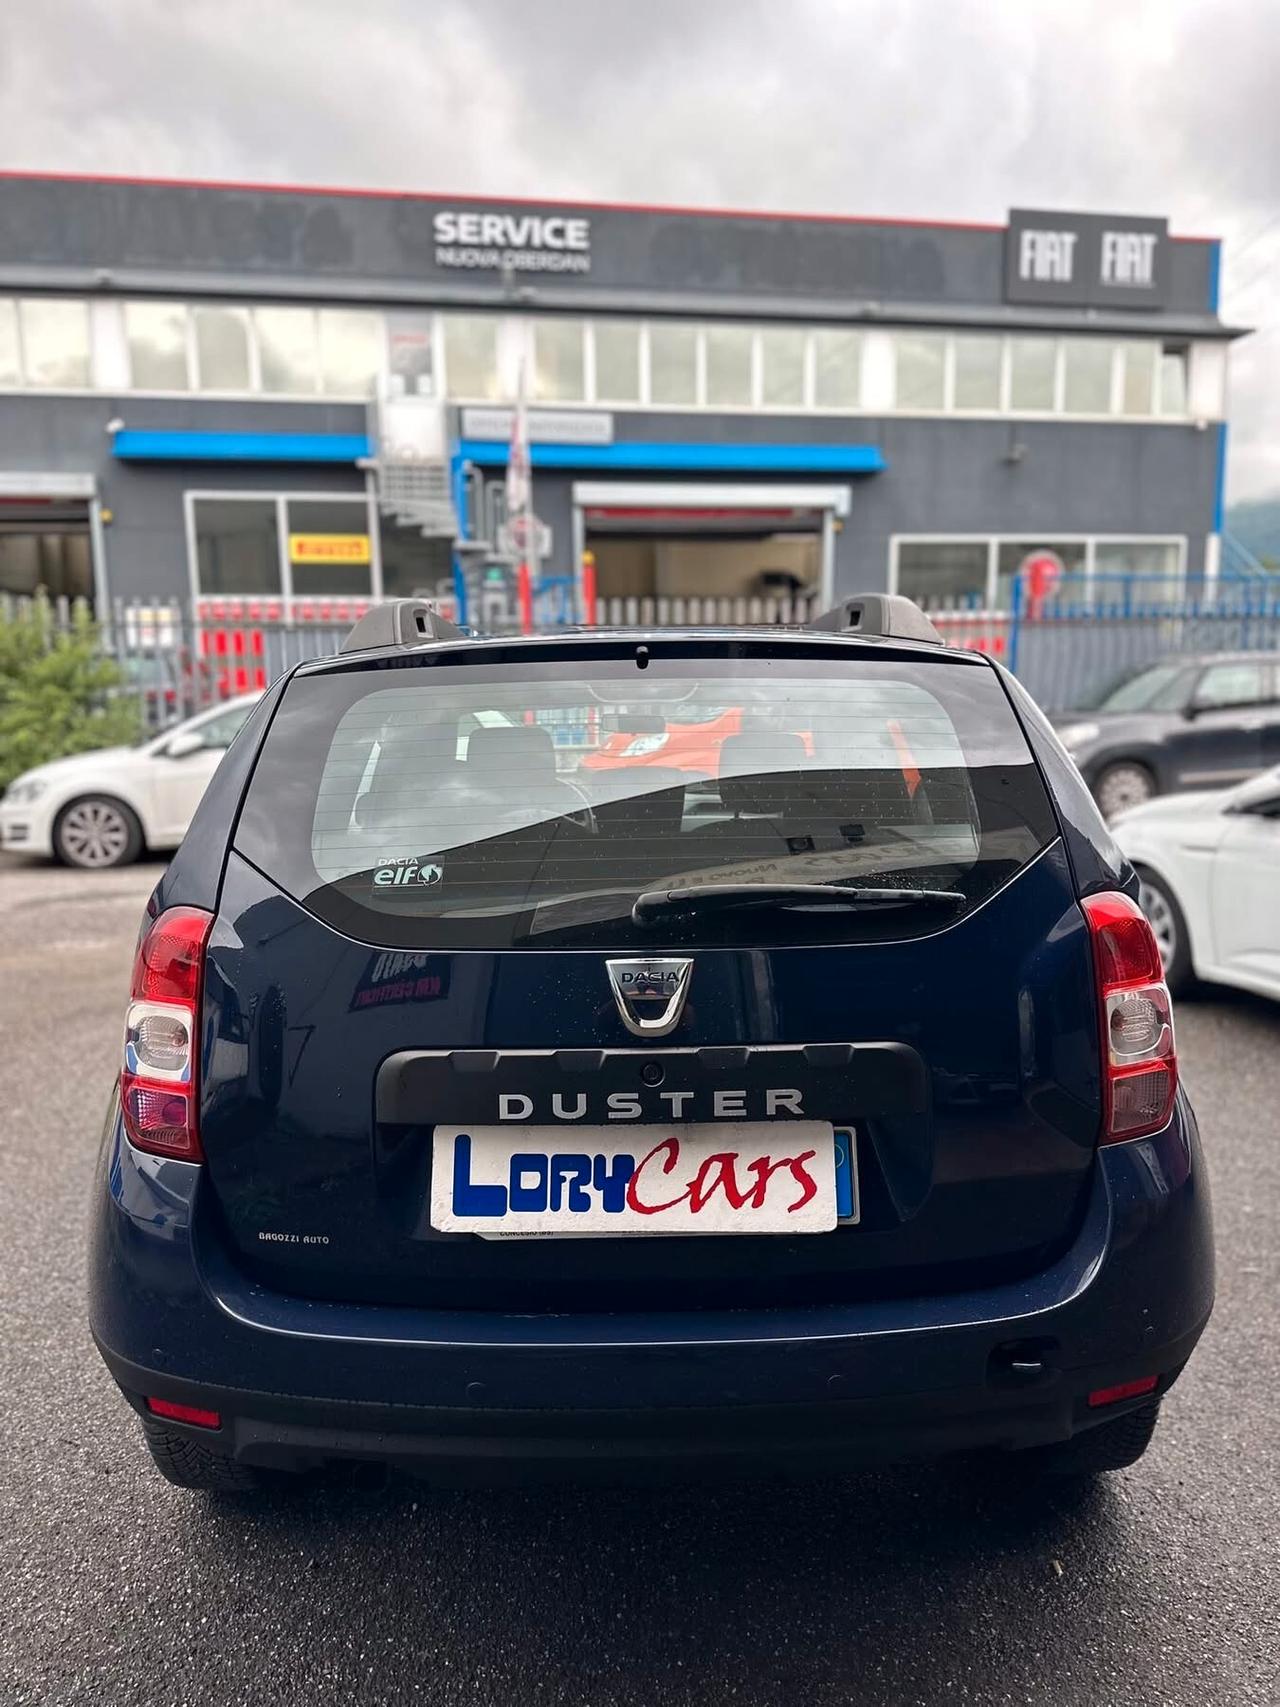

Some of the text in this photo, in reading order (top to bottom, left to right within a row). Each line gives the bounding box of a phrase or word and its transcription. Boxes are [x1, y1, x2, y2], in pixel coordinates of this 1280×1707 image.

[433, 211, 591, 250] SERVICE
[1018, 229, 1077, 282] FIAT
[1100, 231, 1158, 285] FIAT
[378, 857, 419, 866] DACIA
[374, 866, 418, 885] elf
[621, 971, 680, 983] DACIA
[498, 1088, 805, 1121] DUSTER
[258, 1231, 330, 1245] BAGOZZI AUTO
